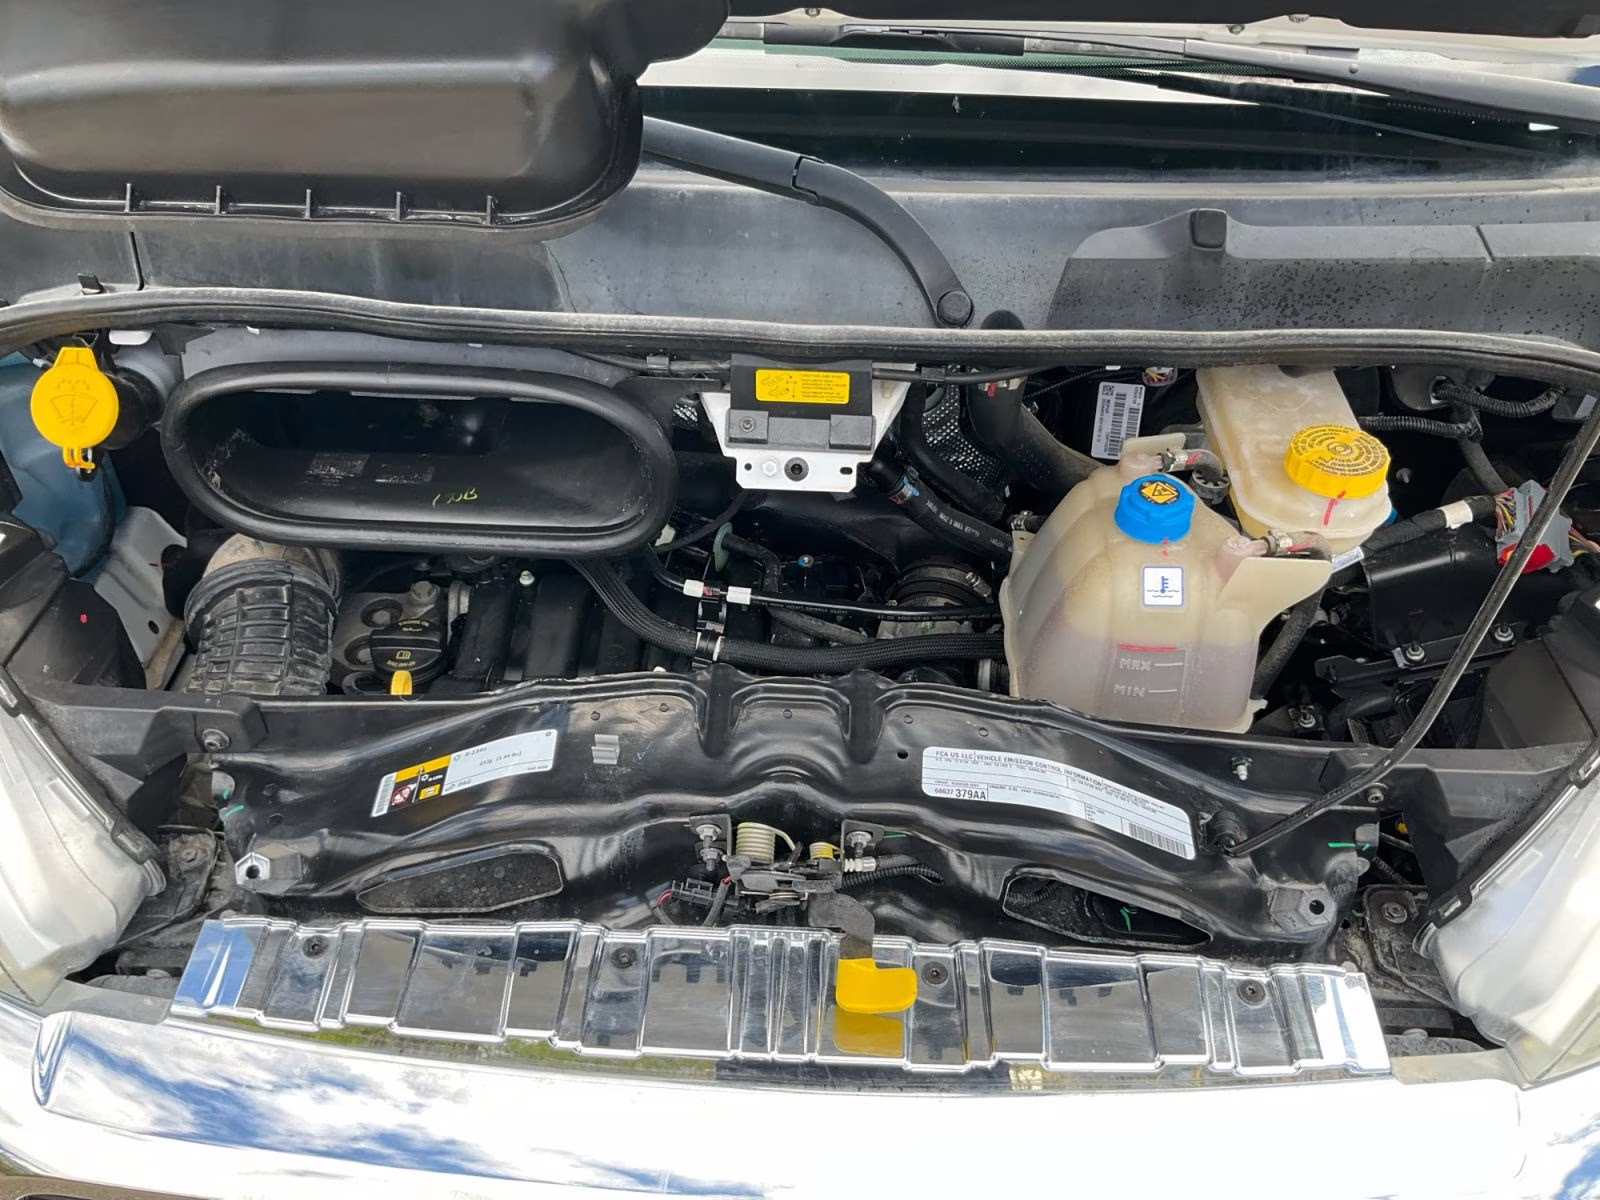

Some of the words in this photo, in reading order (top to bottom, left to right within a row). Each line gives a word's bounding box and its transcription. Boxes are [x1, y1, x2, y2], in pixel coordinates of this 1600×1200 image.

[1120, 658, 1152, 671] MAX
[1114, 684, 1146, 697] MIN
[1003, 757, 1034, 766] EMISSION
[1035, 761, 1062, 772] CONTROL
[1063, 768, 1103, 786] INFORMATION
[955, 788, 987, 800] 379AA
